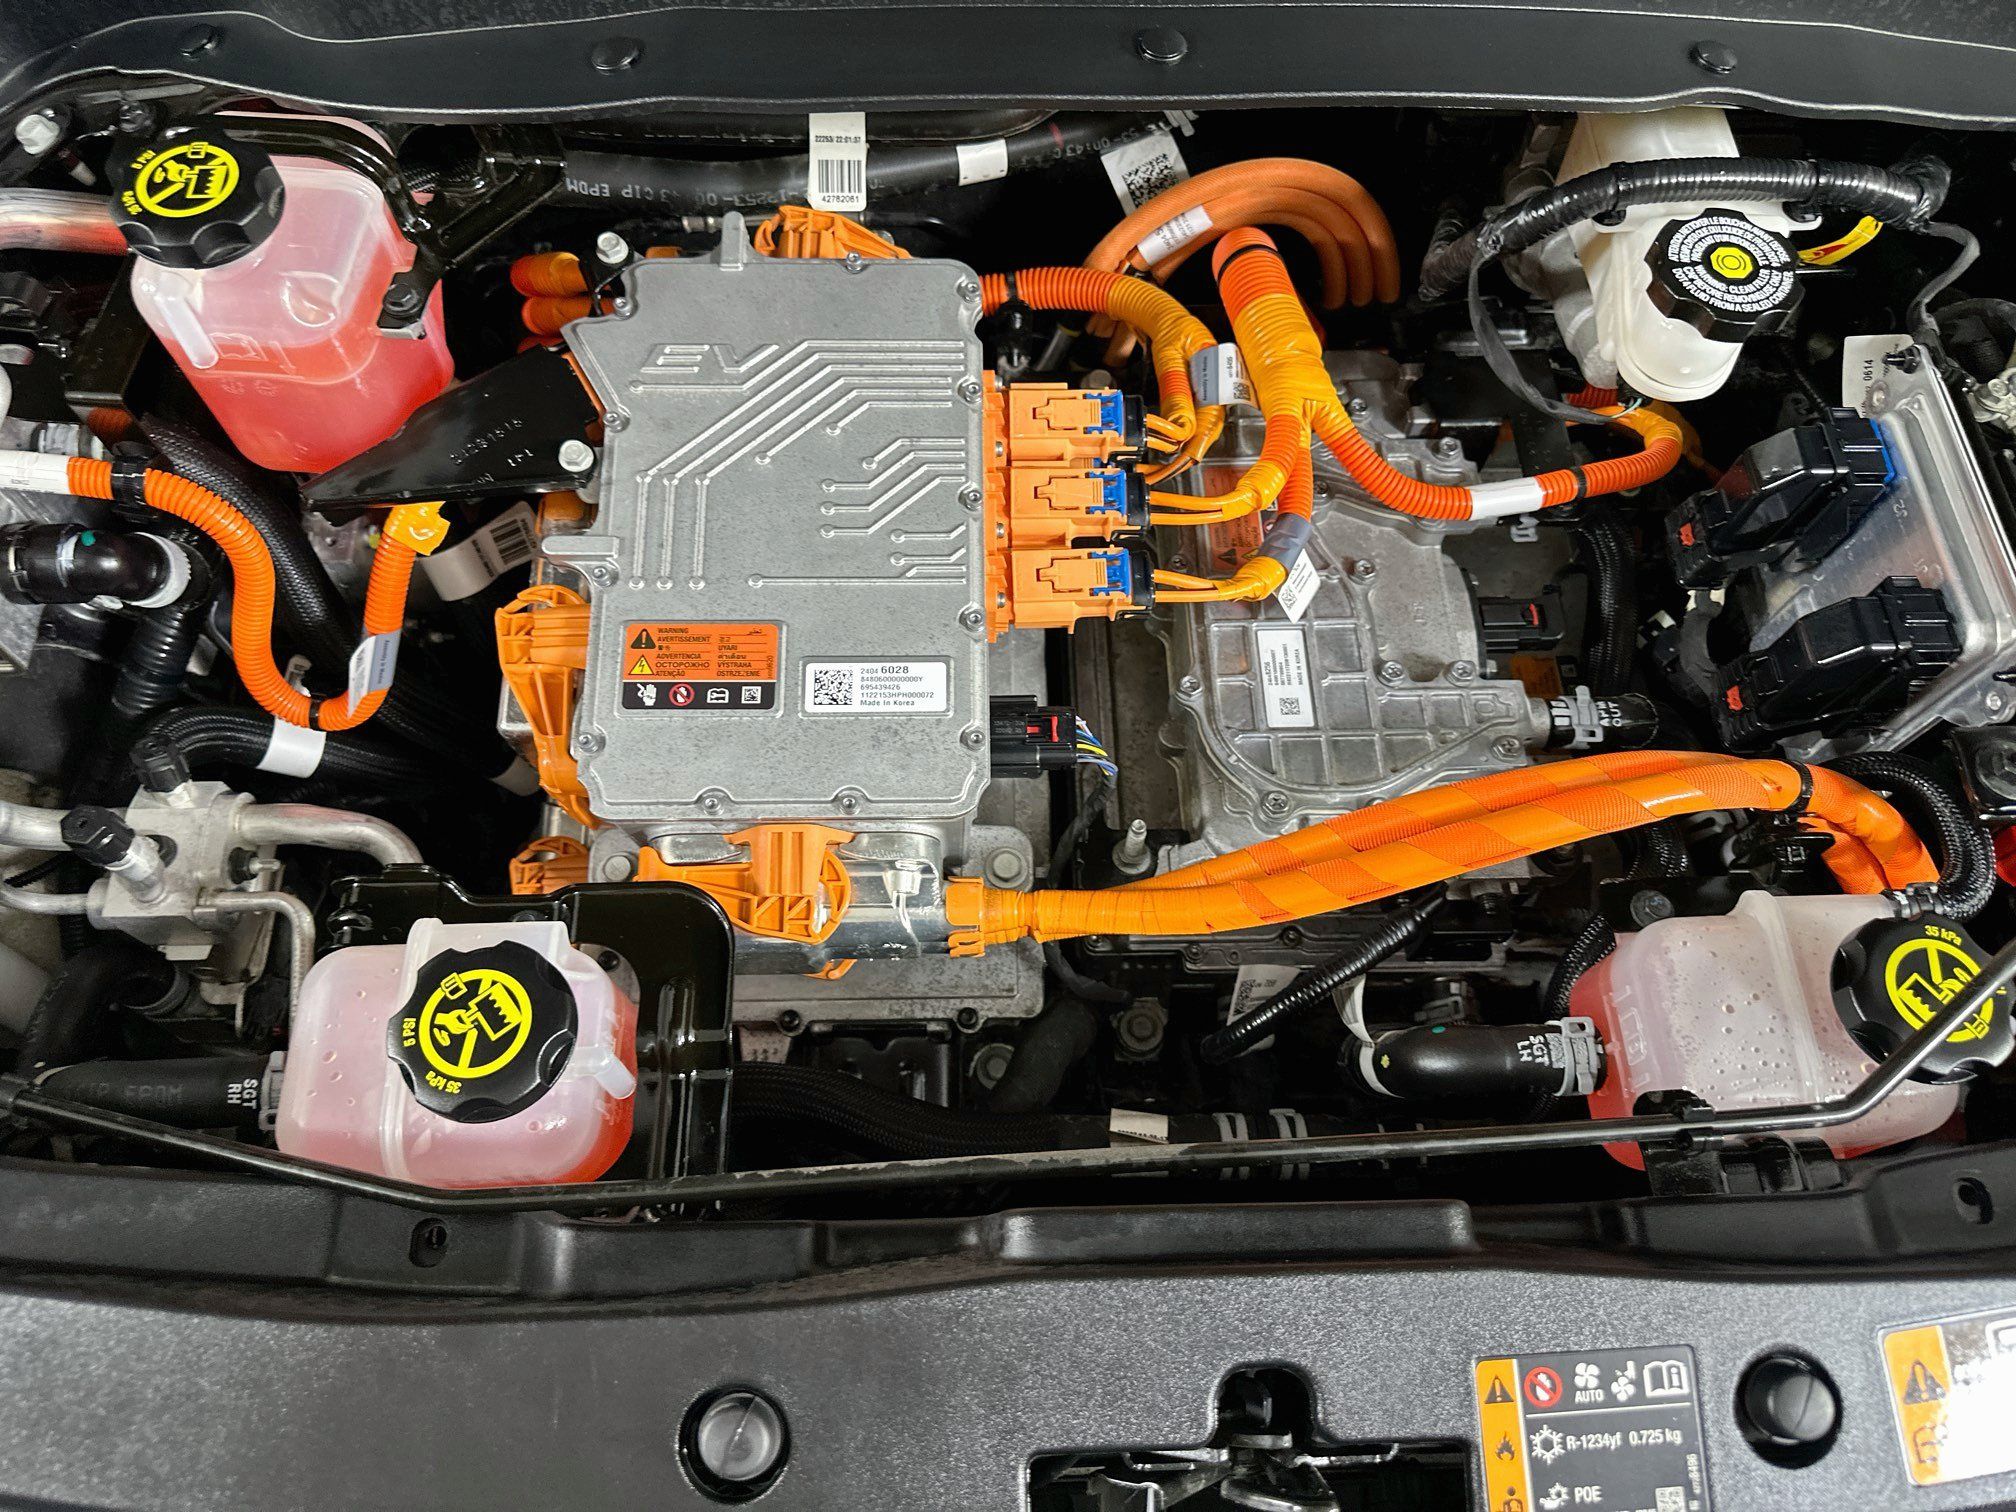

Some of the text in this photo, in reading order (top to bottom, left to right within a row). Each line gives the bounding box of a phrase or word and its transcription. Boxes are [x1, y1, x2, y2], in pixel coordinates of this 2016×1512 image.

[565, 177, 610, 198] EPDM
[1692, 278, 1723, 299] BEFORE
[1728, 283, 1757, 293] CLEAN
[1751, 268, 1770, 289] FILLER
[1684, 283, 1710, 303] FLUID
[1707, 296, 1734, 311] FROM
[1741, 298, 1774, 312] SEALED
[641, 343, 779, 373] EV
[657, 635, 711, 643] AVERTISSEMENT
[655, 661, 710, 669] ОСТОРОЖНО
[655, 669, 686, 678] ATENÇÃO
[881, 665, 909, 674] 6028
[1607, 701, 1622, 727] OUT
[1925, 925, 1962, 946] 35 kPa
[402, 1018, 417, 1037] PSI
[1517, 1040, 1533, 1062] LH
[1529, 1034, 1549, 1066] SGT
[425, 1070, 462, 1094] 35 kPa
[227, 1083, 242, 1104] RH
[242, 1078, 258, 1109] SGT
[1575, 1389, 1604, 1404] AUTO
[1566, 1428, 1682, 1451] R-1234yf 0.725 kg
[1574, 1486, 1602, 1504] POE
